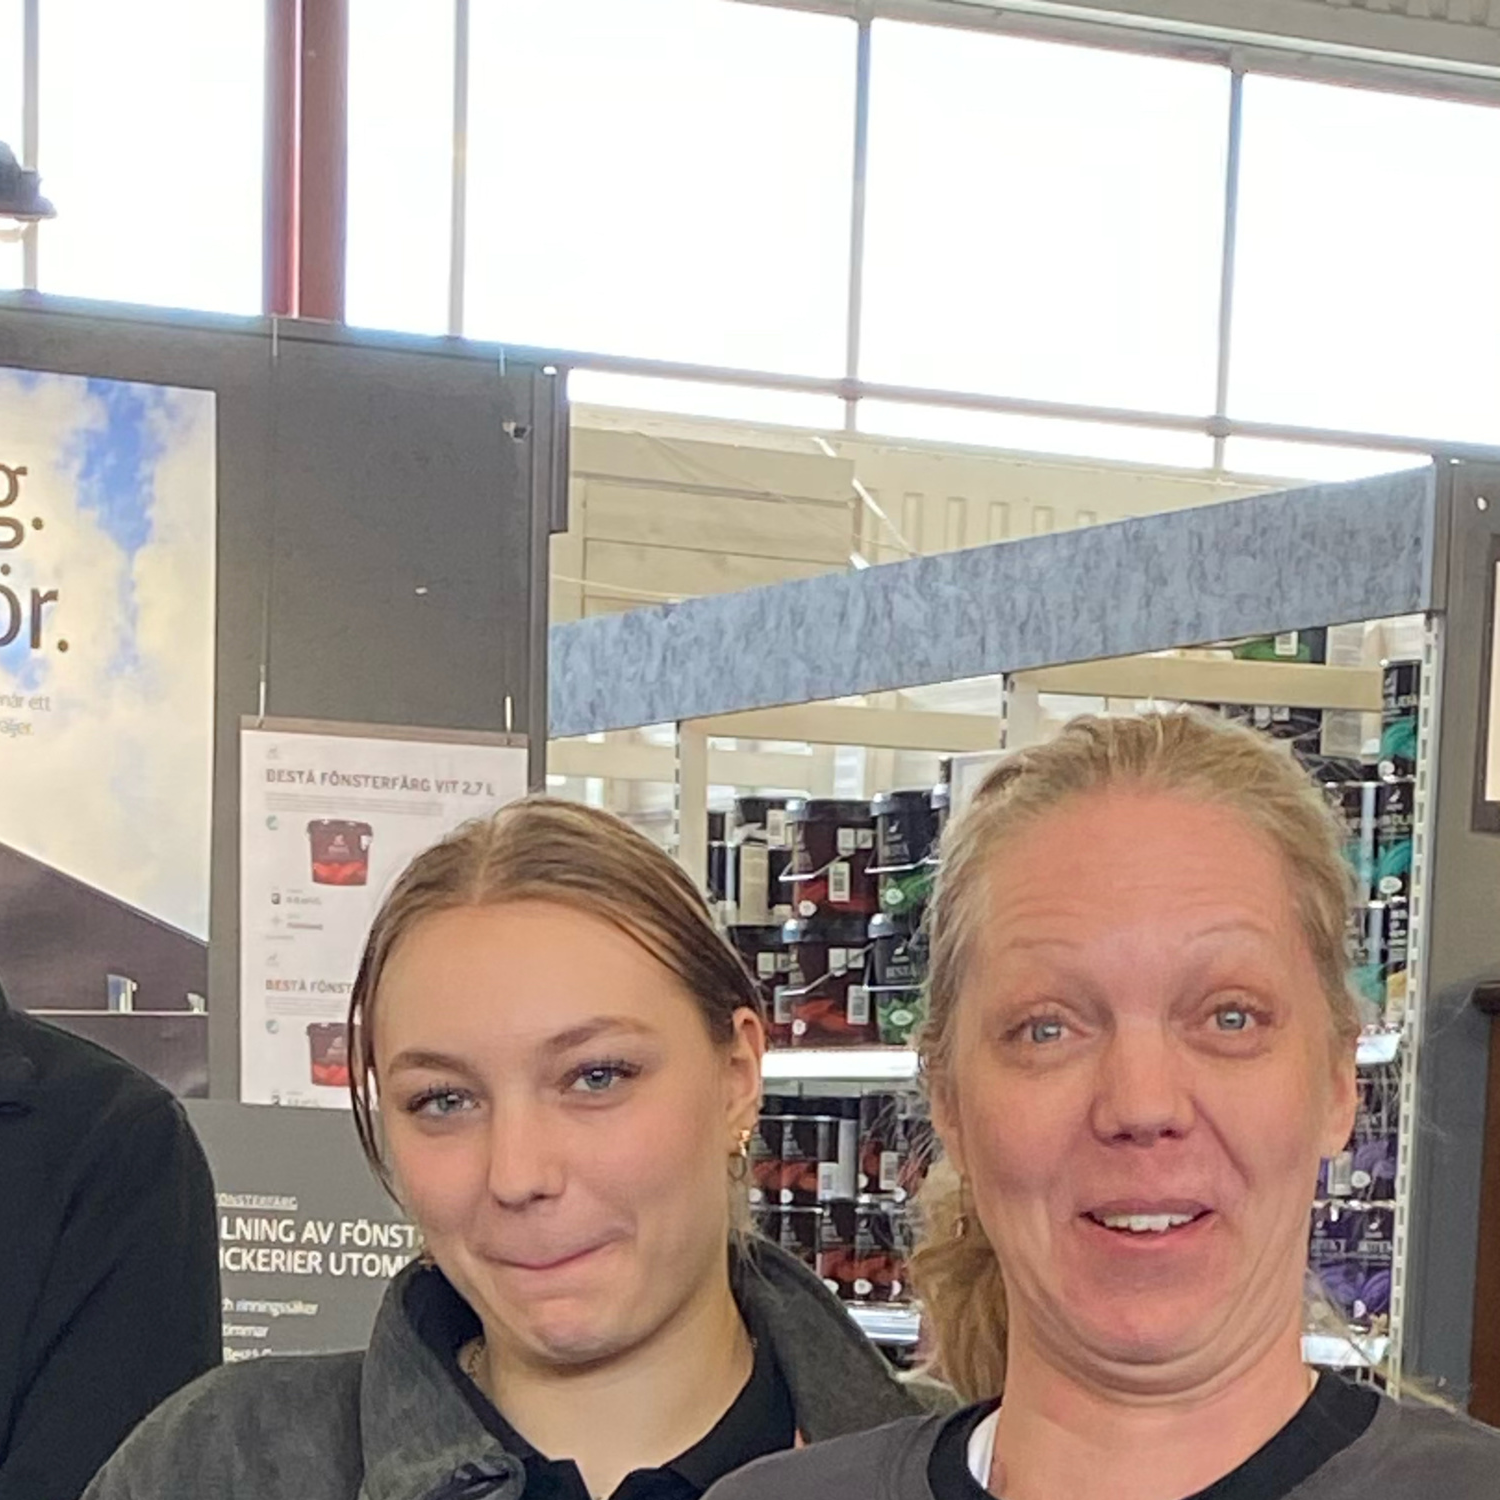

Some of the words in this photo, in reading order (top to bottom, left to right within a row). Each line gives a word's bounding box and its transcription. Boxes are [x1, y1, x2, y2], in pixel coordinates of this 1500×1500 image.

[28, 696, 52, 711] ett
[435, 779, 459, 794] VIT
[300, 1220, 336, 1245] AV
[339, 1218, 421, 1248] FÖNST
[328, 1252, 410, 1279] UTOM
